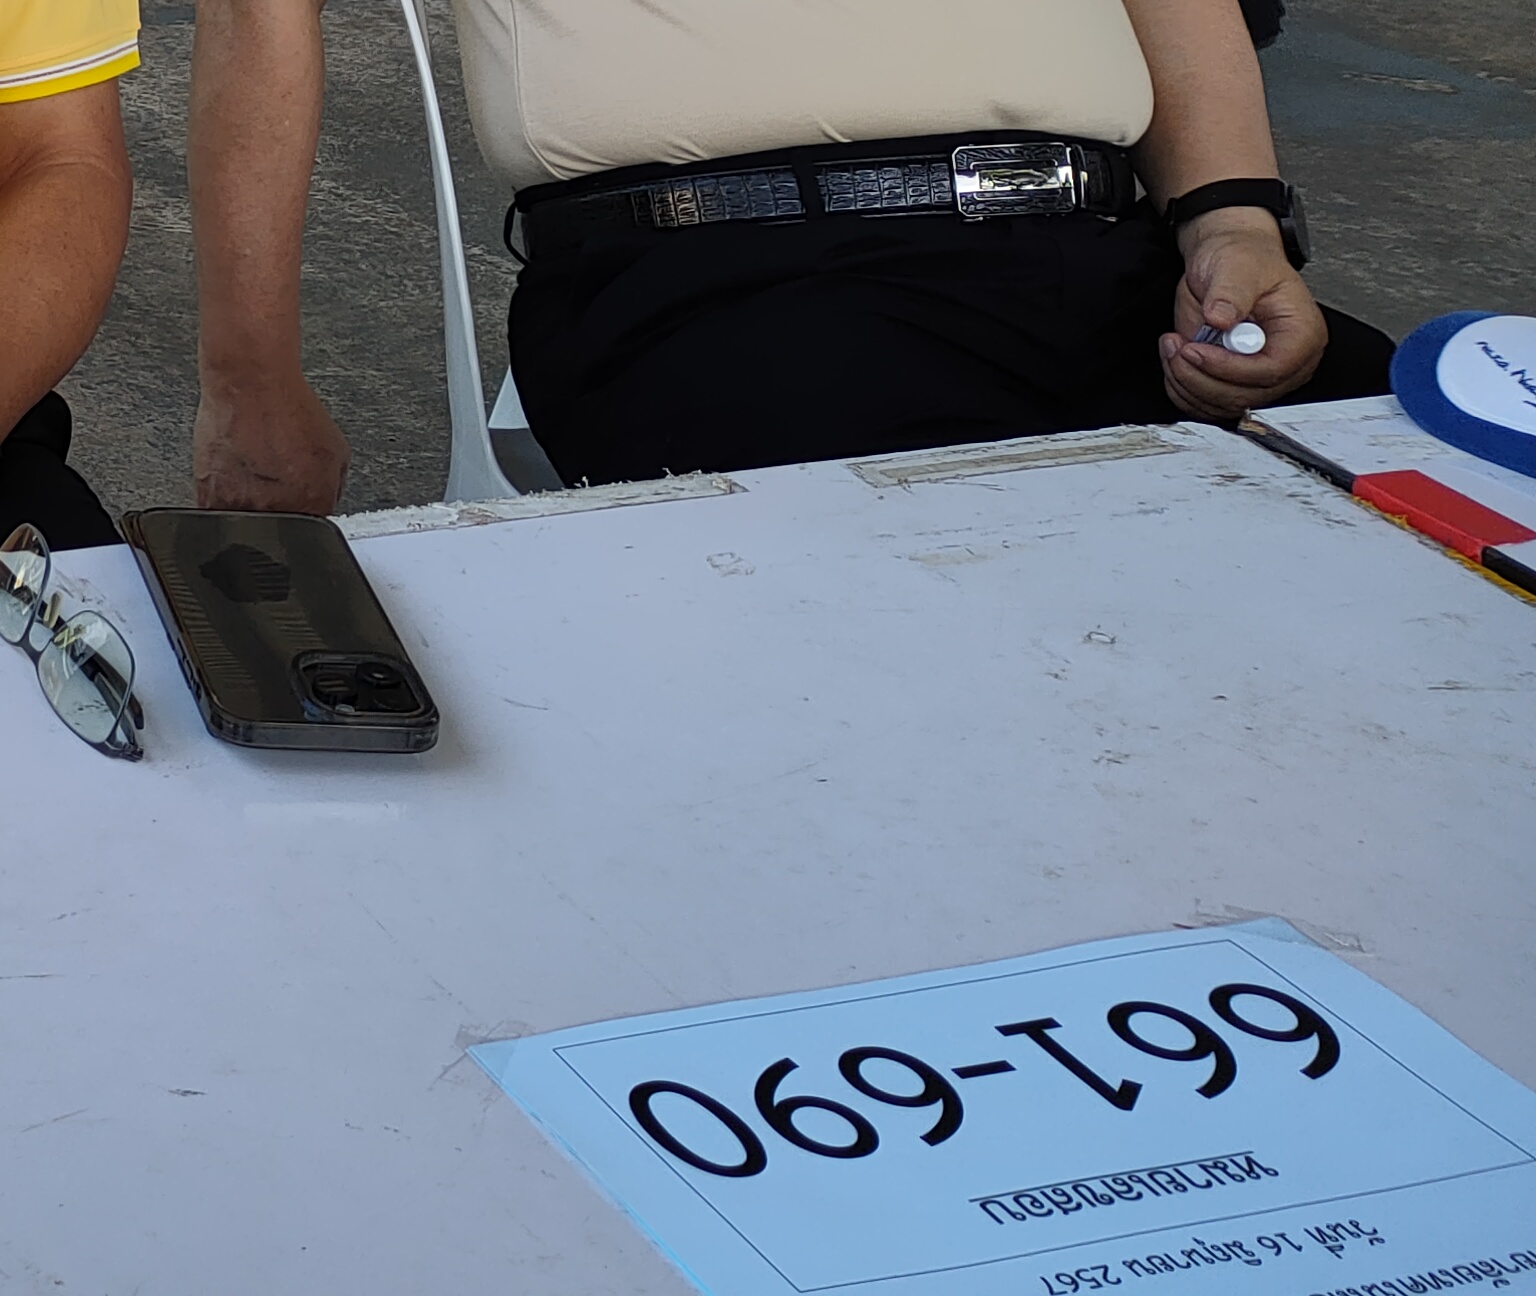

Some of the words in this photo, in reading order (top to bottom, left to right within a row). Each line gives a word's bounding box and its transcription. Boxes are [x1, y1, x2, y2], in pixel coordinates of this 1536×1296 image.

[628, 983, 1341, 1178] 661-690
[979, 1155, 1279, 1225] หมายเลขสอบ
[1122, 1237, 1263, 1278] มิถุนายน
[1256, 1232, 1303, 1257] 16
[1303, 1219, 1386, 1260] วันที่
[1040, 1264, 1122, 1296] 2567
